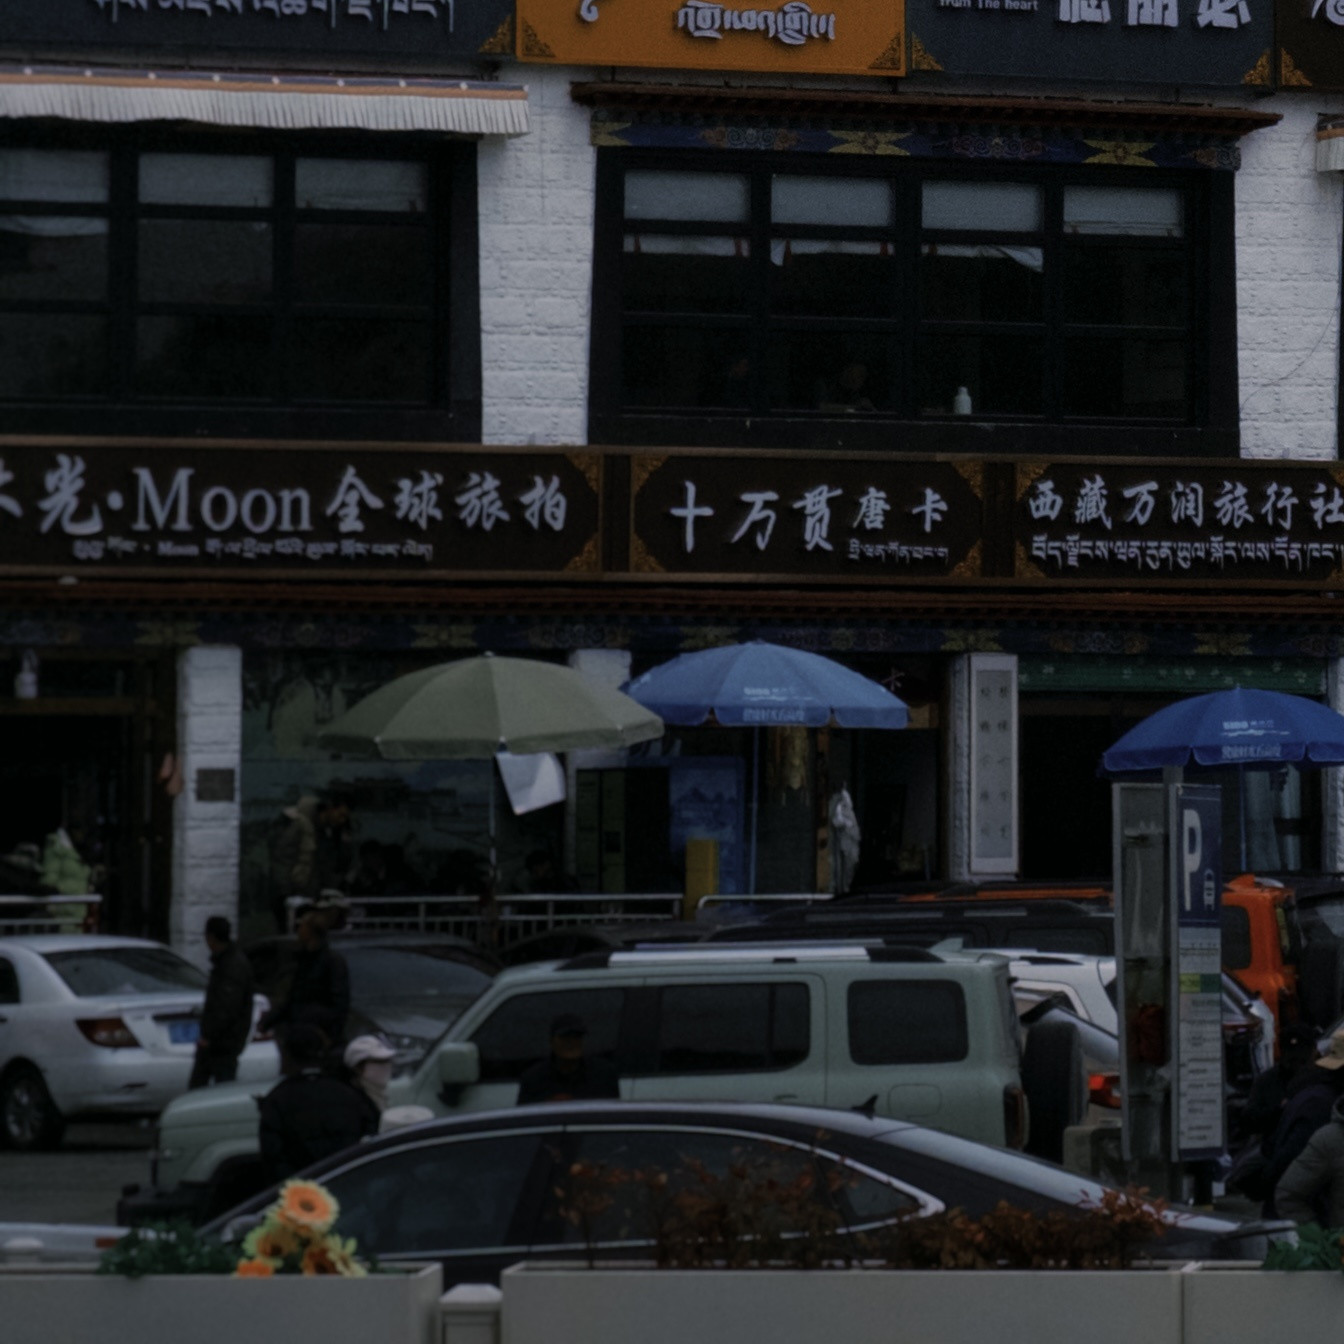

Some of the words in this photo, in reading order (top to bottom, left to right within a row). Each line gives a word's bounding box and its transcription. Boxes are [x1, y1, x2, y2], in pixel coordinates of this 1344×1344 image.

[671, 481, 948, 553] 十万贯唐卡
[1183, 808, 1203, 912] P
